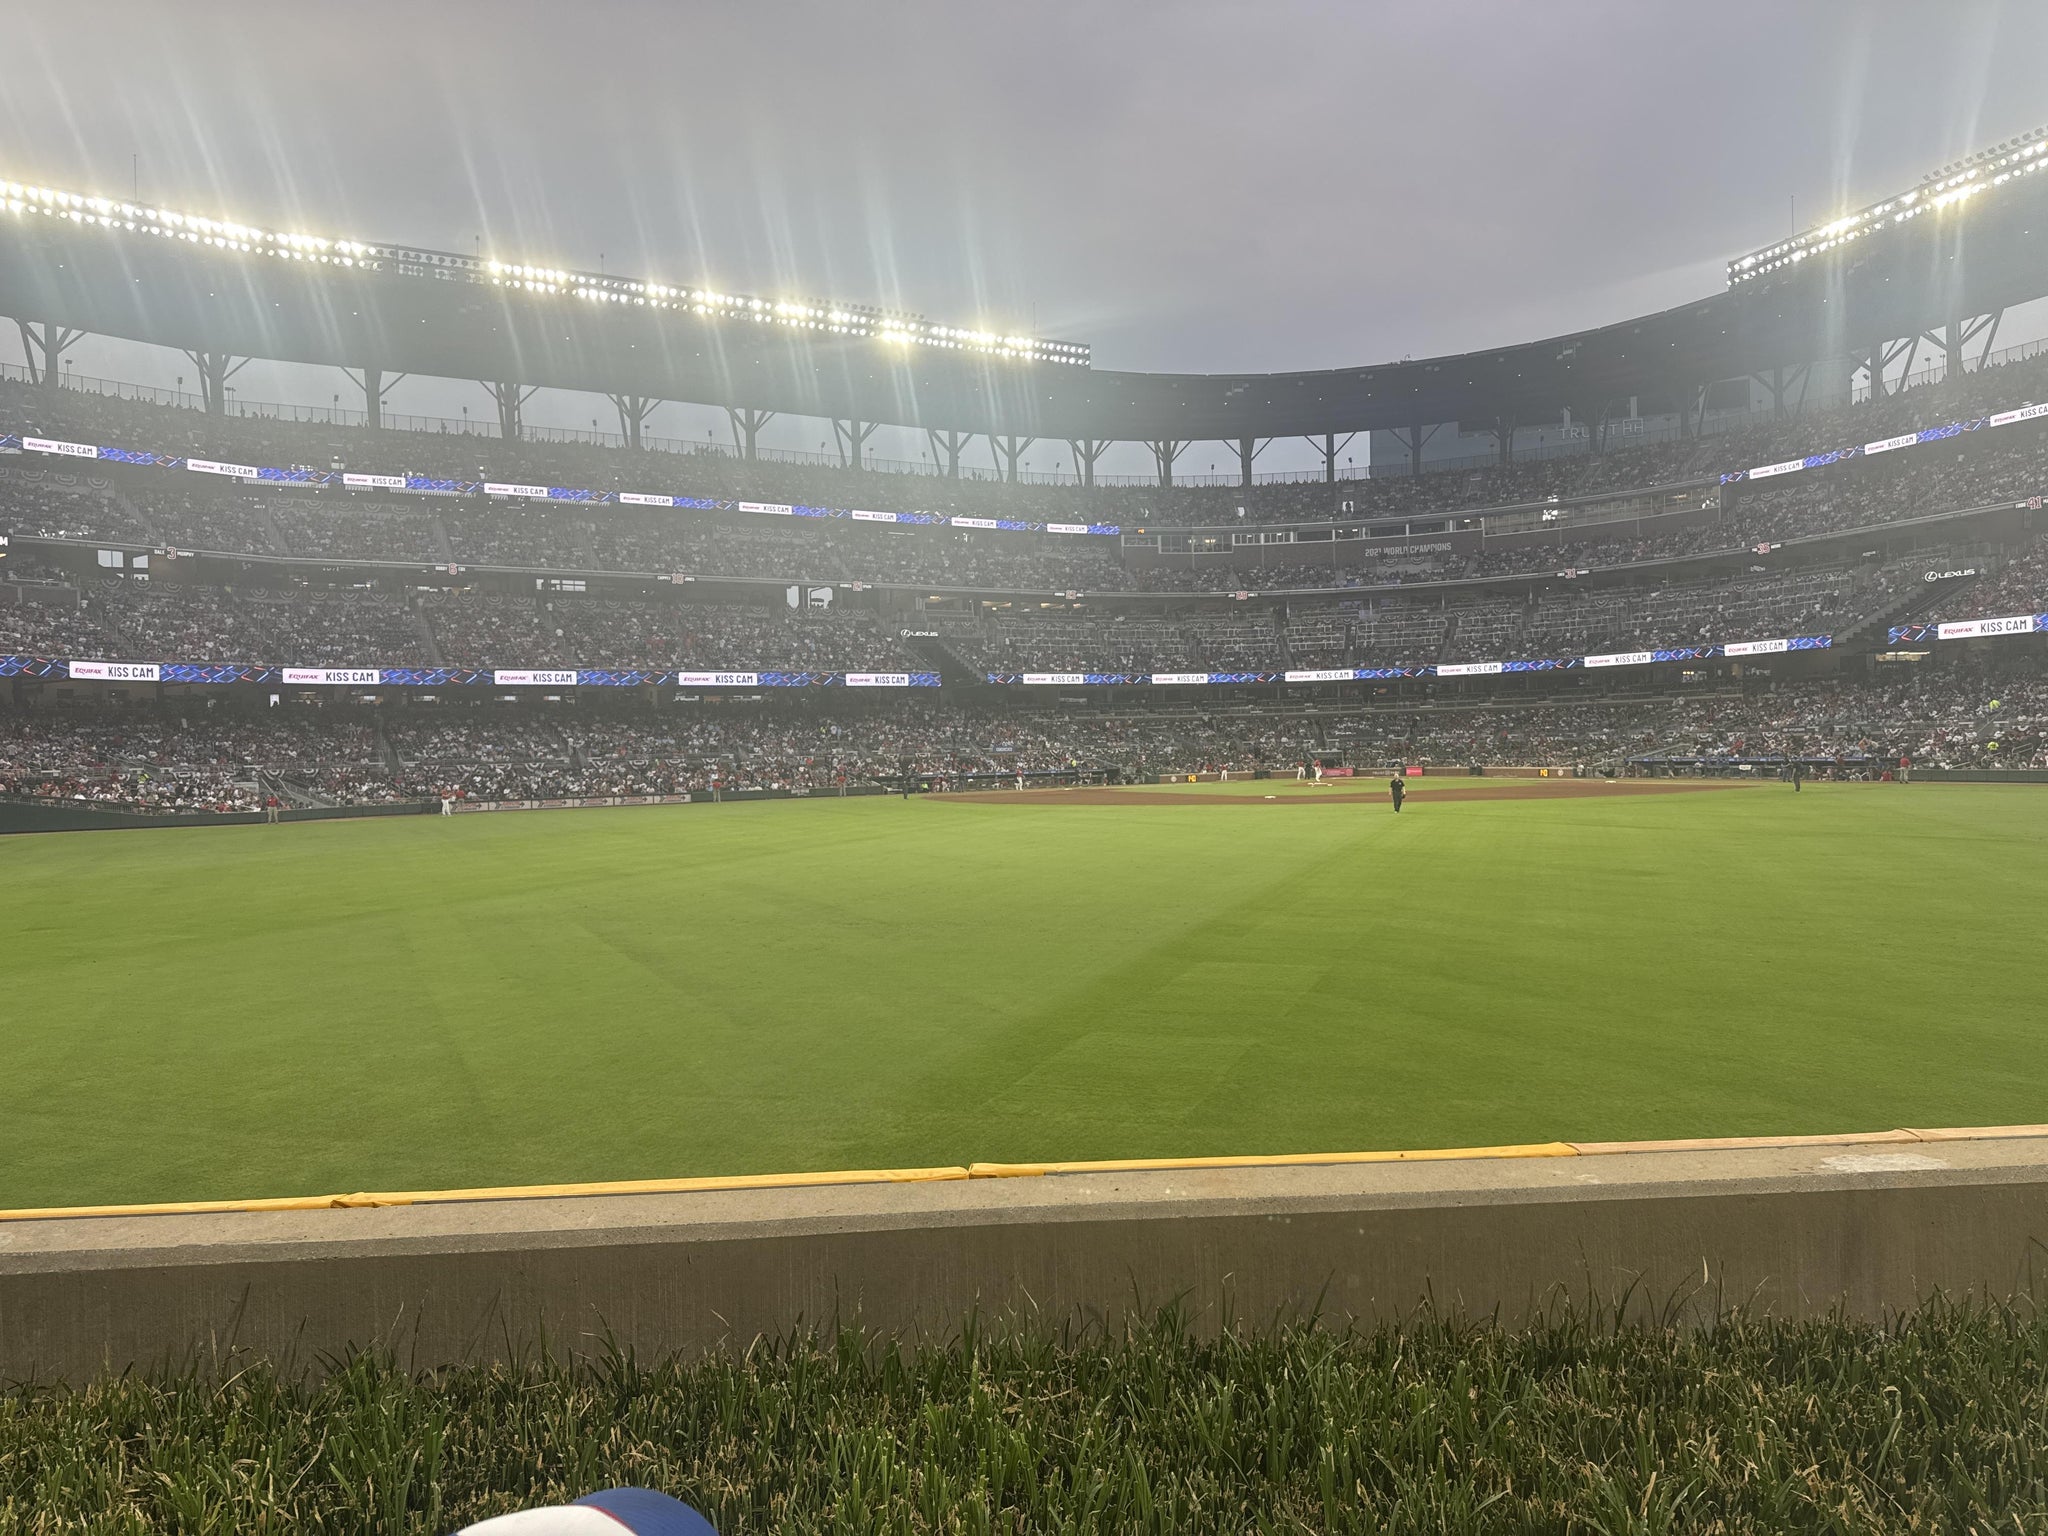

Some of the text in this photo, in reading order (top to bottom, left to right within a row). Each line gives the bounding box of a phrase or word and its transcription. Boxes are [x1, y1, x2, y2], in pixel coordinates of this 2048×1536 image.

[2020, 408, 2037, 418] KISS
[2038, 405, 2048, 415] CA
[1887, 439, 1900, 448] KISS
[1901, 436, 1914, 445] CAM
[57, 444, 75, 453] KISS
[77, 446, 93, 456] CAM
[220, 465, 237, 474] KISS
[238, 467, 253, 476] CAM
[1773, 464, 1787, 473] KISS
[1788, 462, 1800, 471] CAM
[372, 477, 387, 485] KISS
[644, 496, 657, 504] KISS
[2027, 495, 2042, 510] 41
[167, 546, 177, 560] 3
[1383, 546, 1408, 556] WORLD
[1410, 542, 1452, 554] CHAMPIONS
[1938, 568, 1976, 579] LEXUS
[1944, 619, 2027, 635] EQUIFAX KISS CAM
[1752, 644, 1767, 652] KISS
[1770, 642, 1784, 650] CAM
[1615, 655, 1631, 664] KISS
[1632, 654, 1647, 663] CAM
[75, 666, 154, 678] EQUIFAX KISS CAM
[1467, 665, 1482, 673] KISS
[1483, 664, 1499, 672] CAM
[289, 672, 374, 682] EQUIFAX KISS CAM
[533, 673, 553, 682] KISS
[554, 674, 573, 682] CAM
[715, 675, 734, 684] KISS
[736, 675, 753, 683] CAM
[875, 676, 890, 684] KISS
[891, 676, 906, 684] CAM
[1051, 675, 1065, 683] KISS
[1177, 675, 1190, 683] KISS
[1334, 671, 1350, 679] CAM
